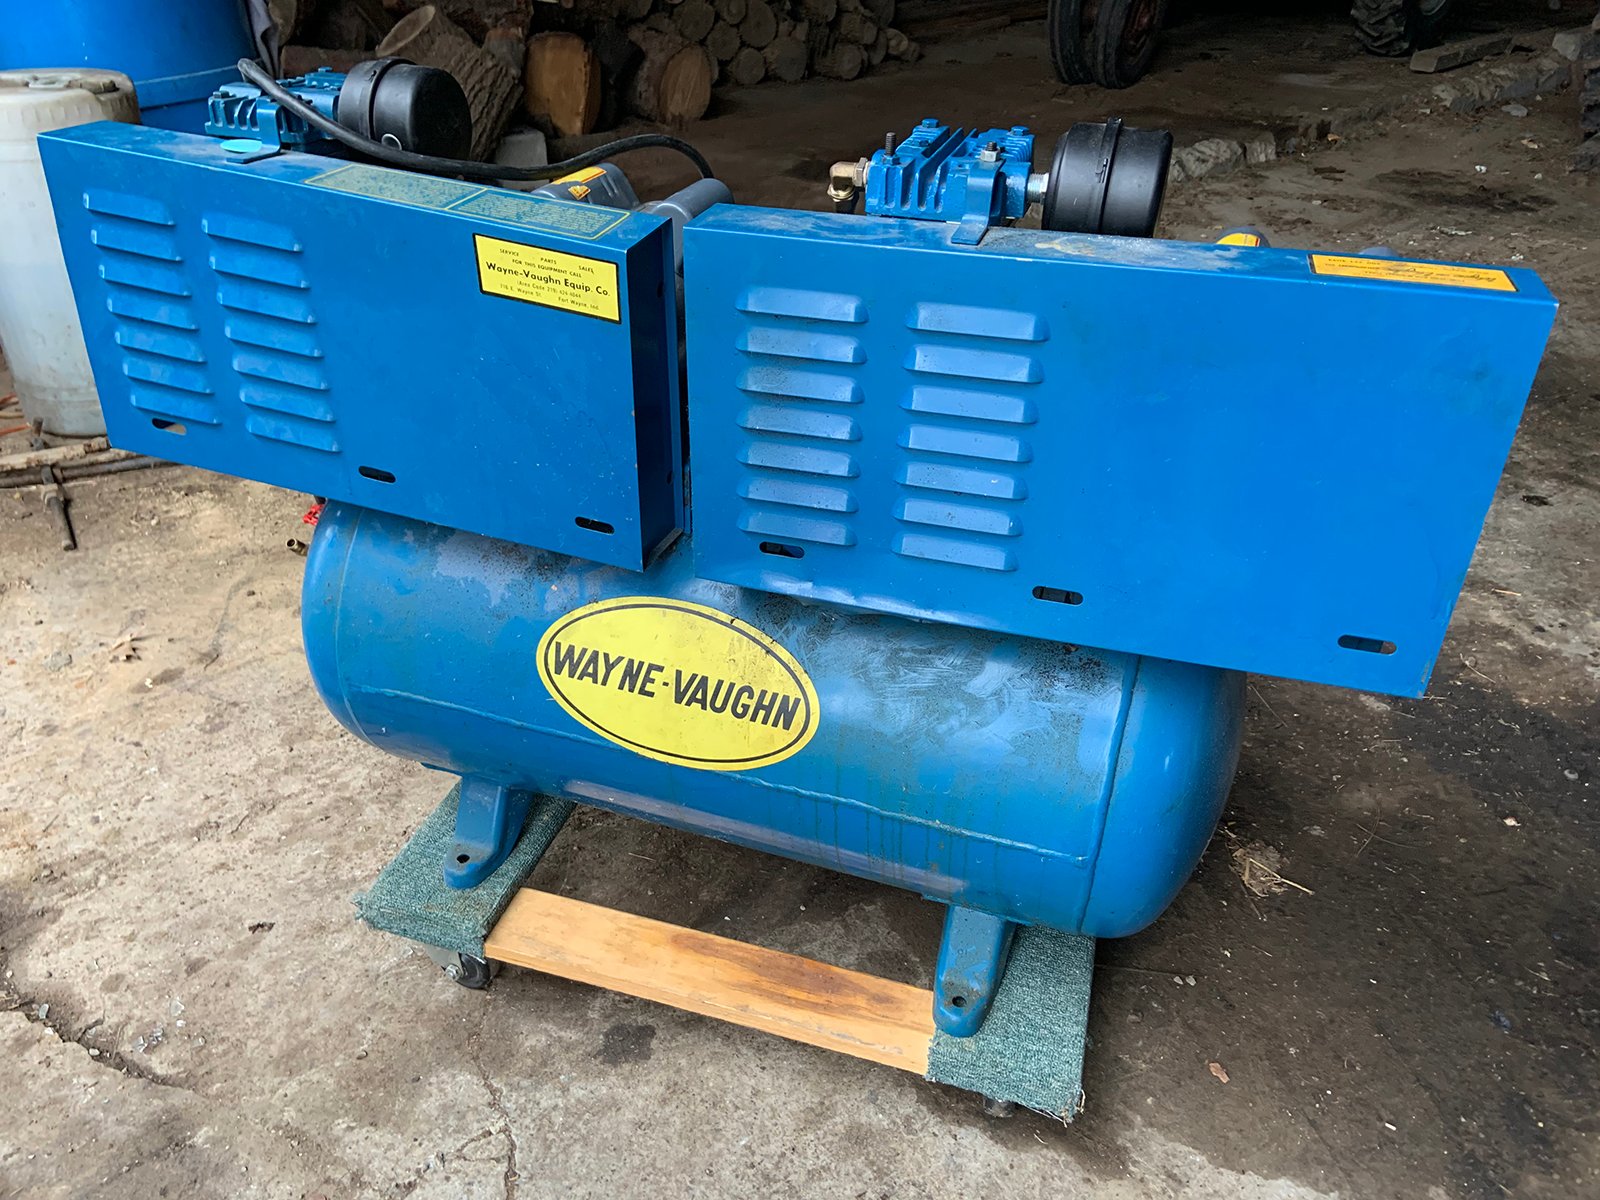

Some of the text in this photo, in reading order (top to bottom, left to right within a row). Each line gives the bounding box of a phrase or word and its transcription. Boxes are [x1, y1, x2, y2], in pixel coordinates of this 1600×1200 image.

[500, 248, 519, 256] SERVICE
[578, 265, 594, 274] SALES
[538, 264, 567, 274] EQUIPMENT
[486, 261, 610, 296] Wayne-Vaughn Equip. Co.
[517, 287, 533, 296] Wayne
[554, 641, 801, 731] WAYNE-VAUGHN
